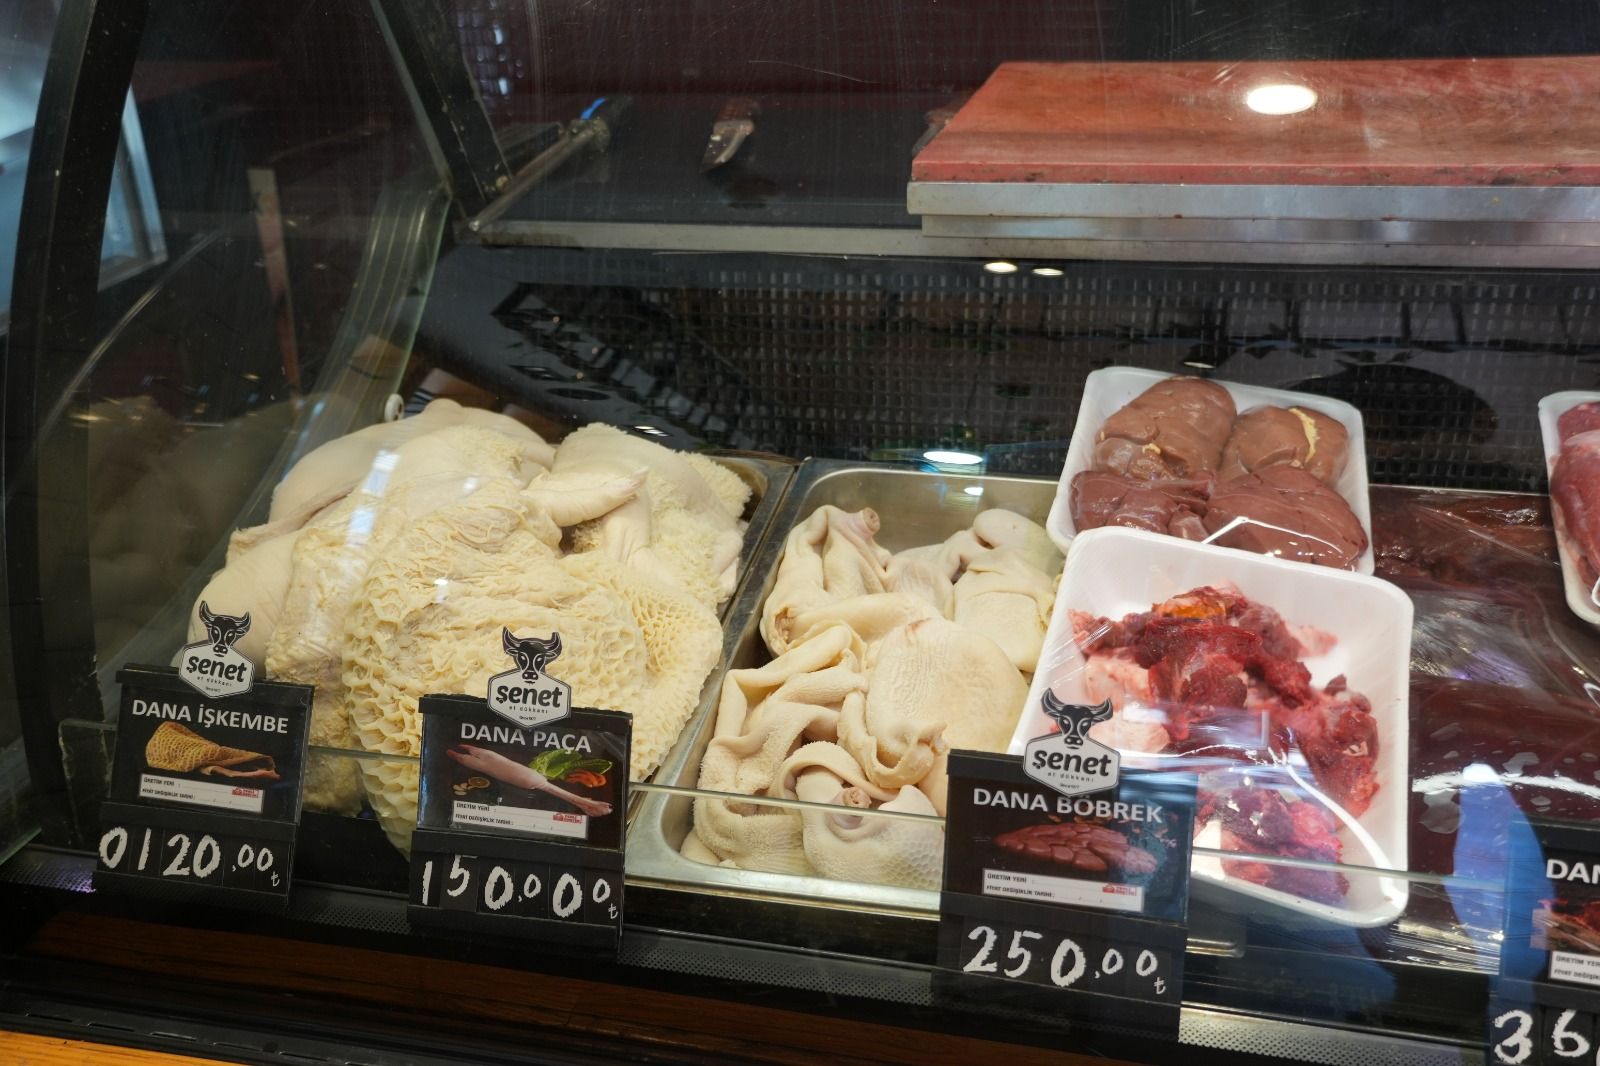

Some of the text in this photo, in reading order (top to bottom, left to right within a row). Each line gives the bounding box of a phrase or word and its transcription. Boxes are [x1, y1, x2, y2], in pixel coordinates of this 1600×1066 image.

[132, 700, 289, 734] DANA İŞKEMBE
[460, 722, 592, 755] DANA PAÇA
[973, 788, 1163, 823] DANA BÖBREK
